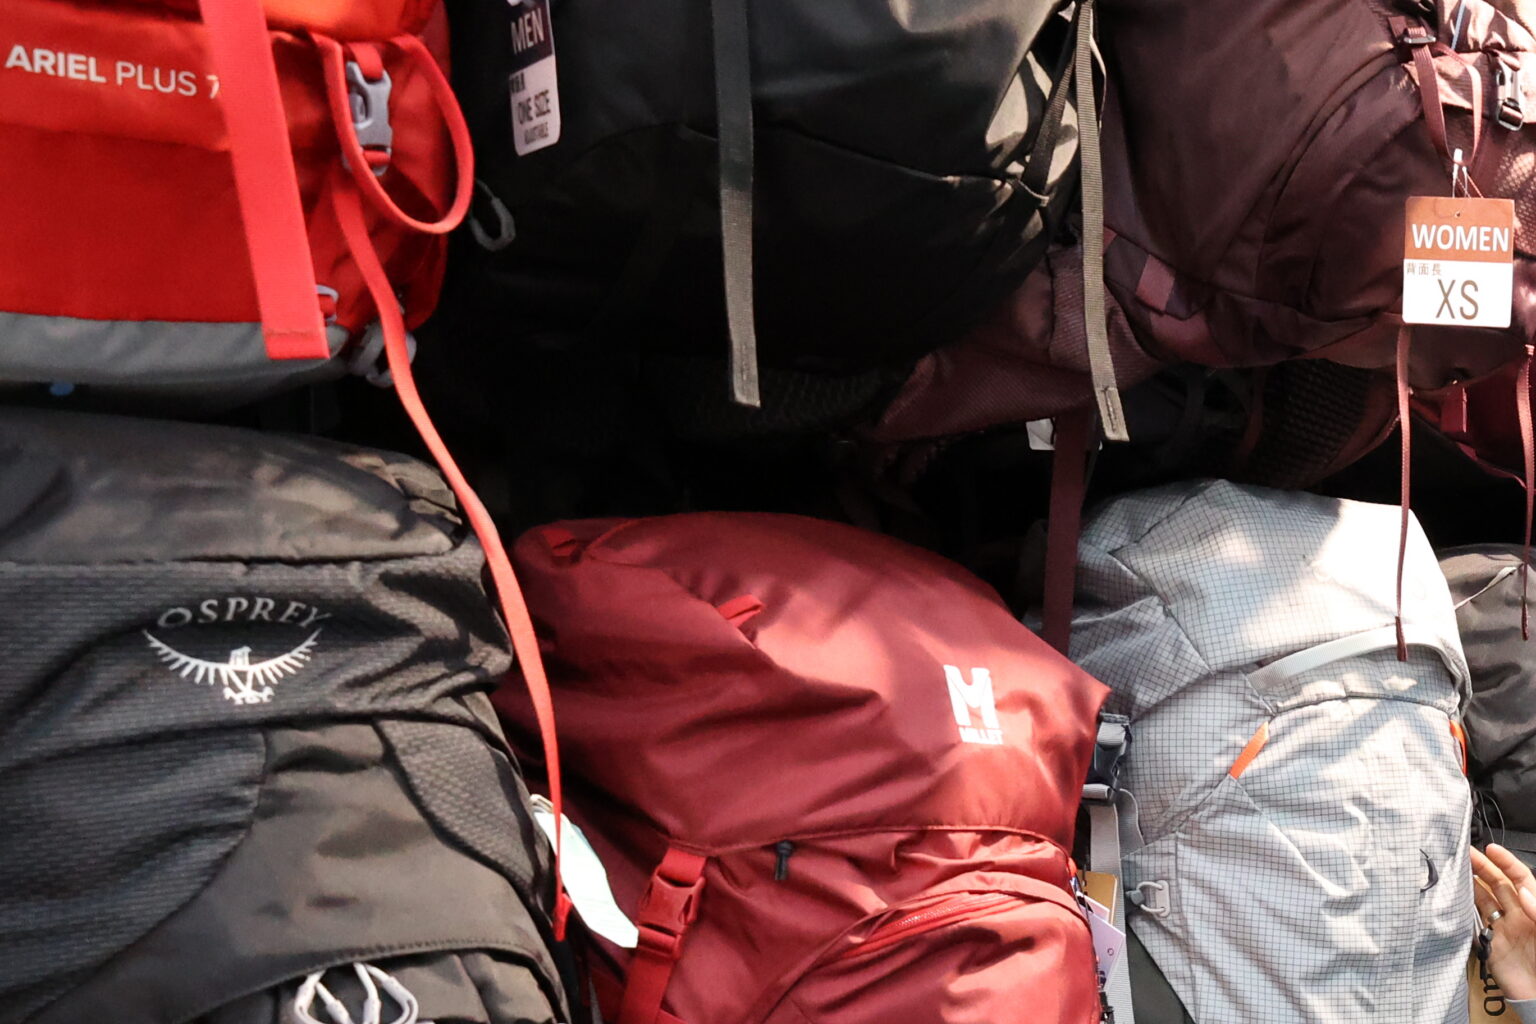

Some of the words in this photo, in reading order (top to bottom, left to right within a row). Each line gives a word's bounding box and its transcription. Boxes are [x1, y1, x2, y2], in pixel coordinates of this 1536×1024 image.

[510, 7, 545, 55] MEN
[5, 44, 107, 83] ARIEL
[115, 60, 198, 97] PLUS
[1411, 223, 1509, 252] WOMEN
[1406, 262, 1442, 276] 背面長
[1435, 279, 1479, 320] XS
[157, 597, 332, 628] OSPREY
